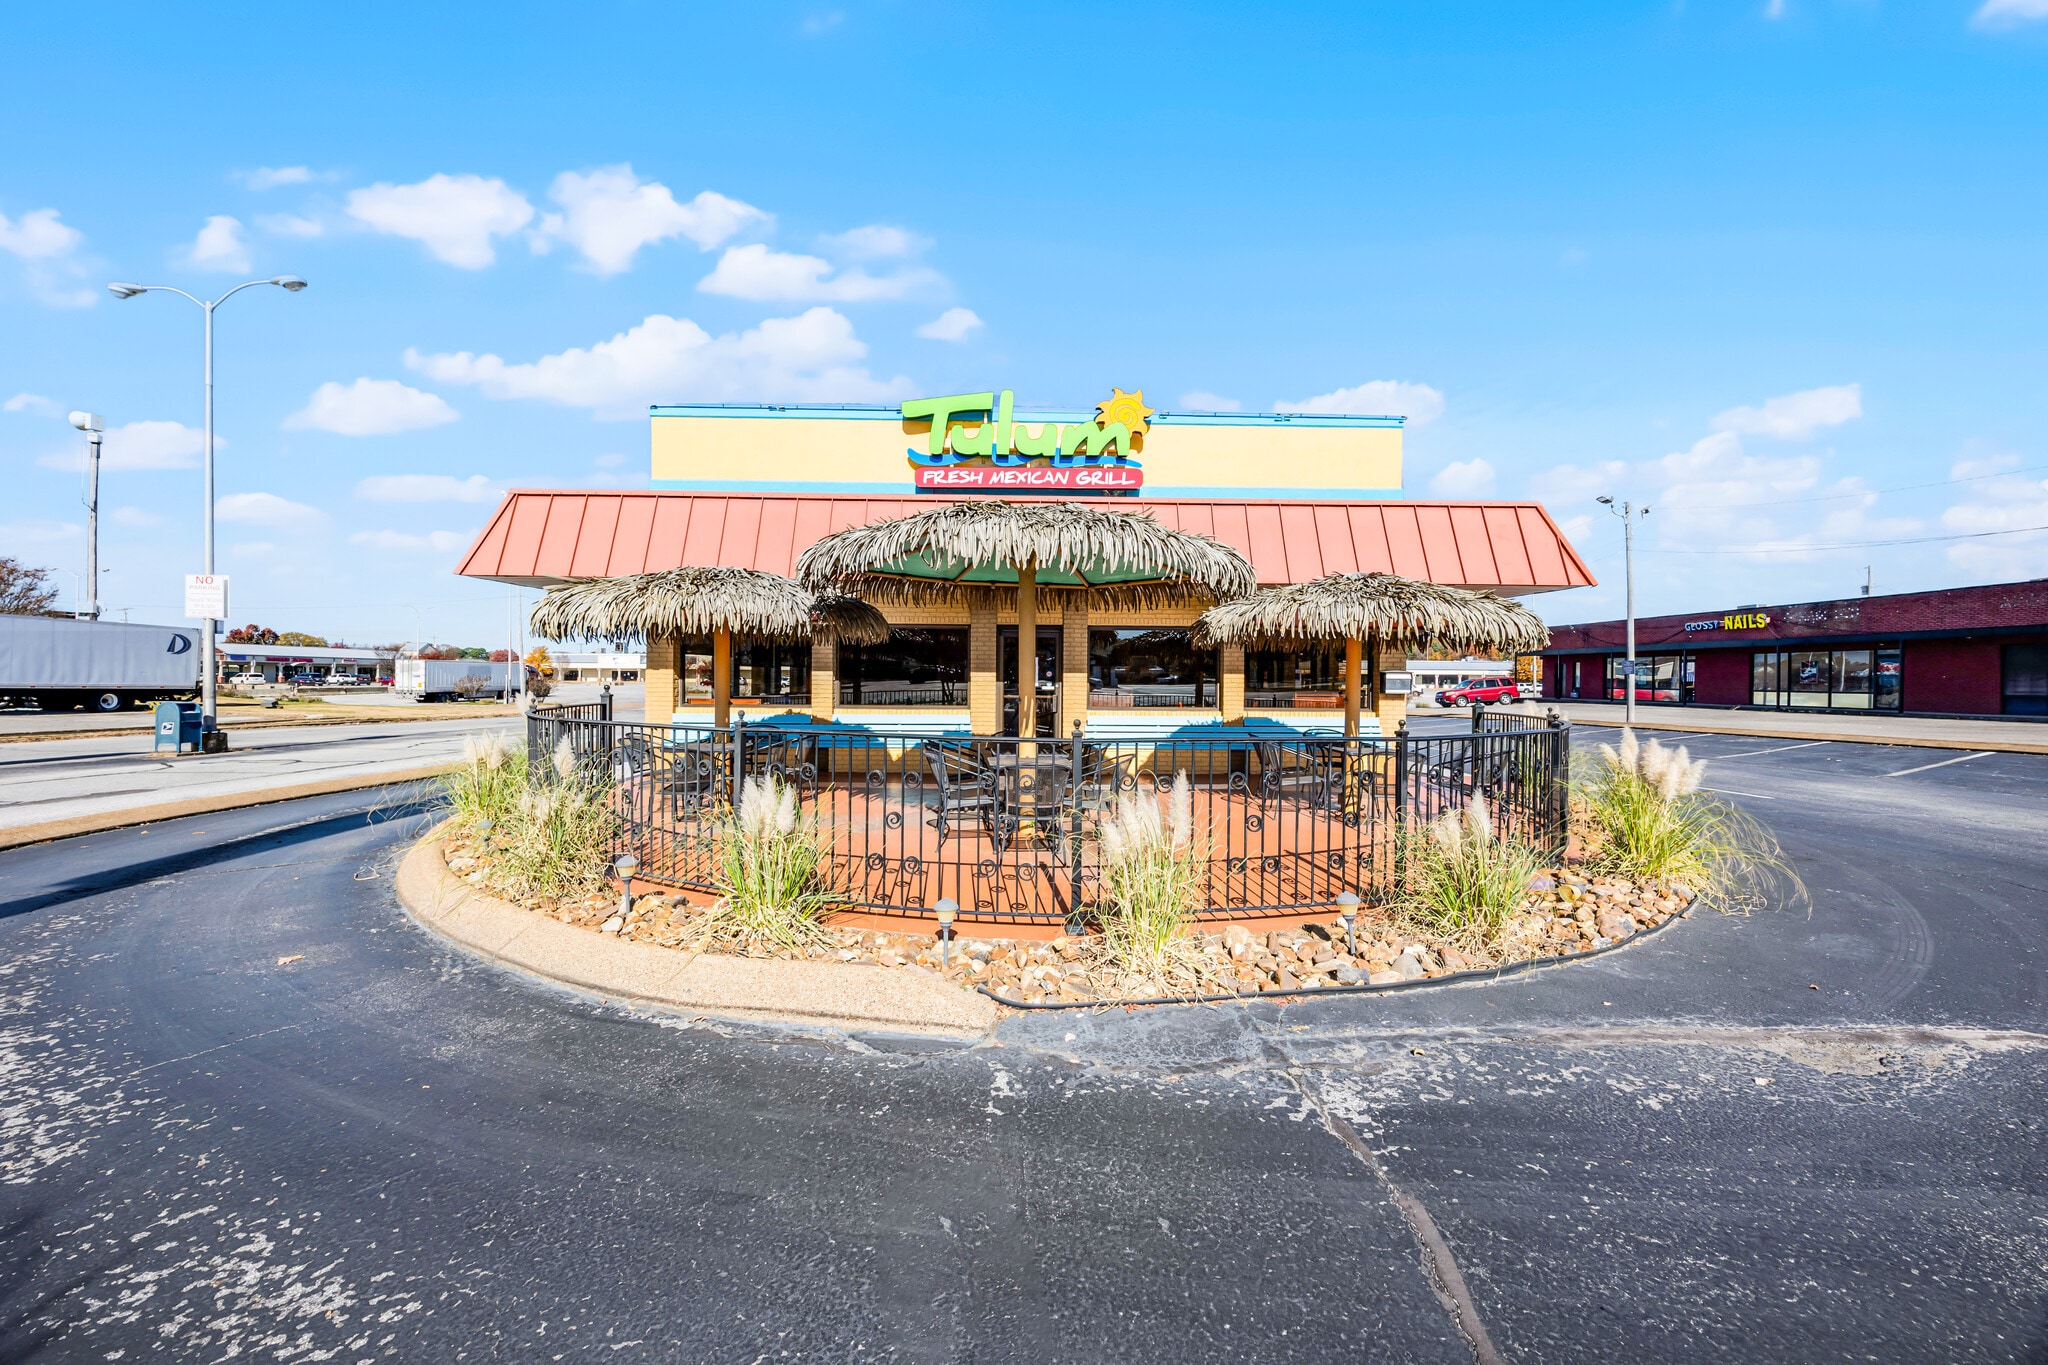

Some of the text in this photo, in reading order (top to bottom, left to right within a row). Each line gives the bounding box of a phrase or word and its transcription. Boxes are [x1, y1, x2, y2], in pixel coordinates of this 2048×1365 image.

[901, 389, 1130, 456] Tulum
[922, 470, 1135, 486] FRESH MEXICAN GRILL
[195, 576, 214, 584] NO
[1684, 613, 1766, 631] GLOSSY NAILS
